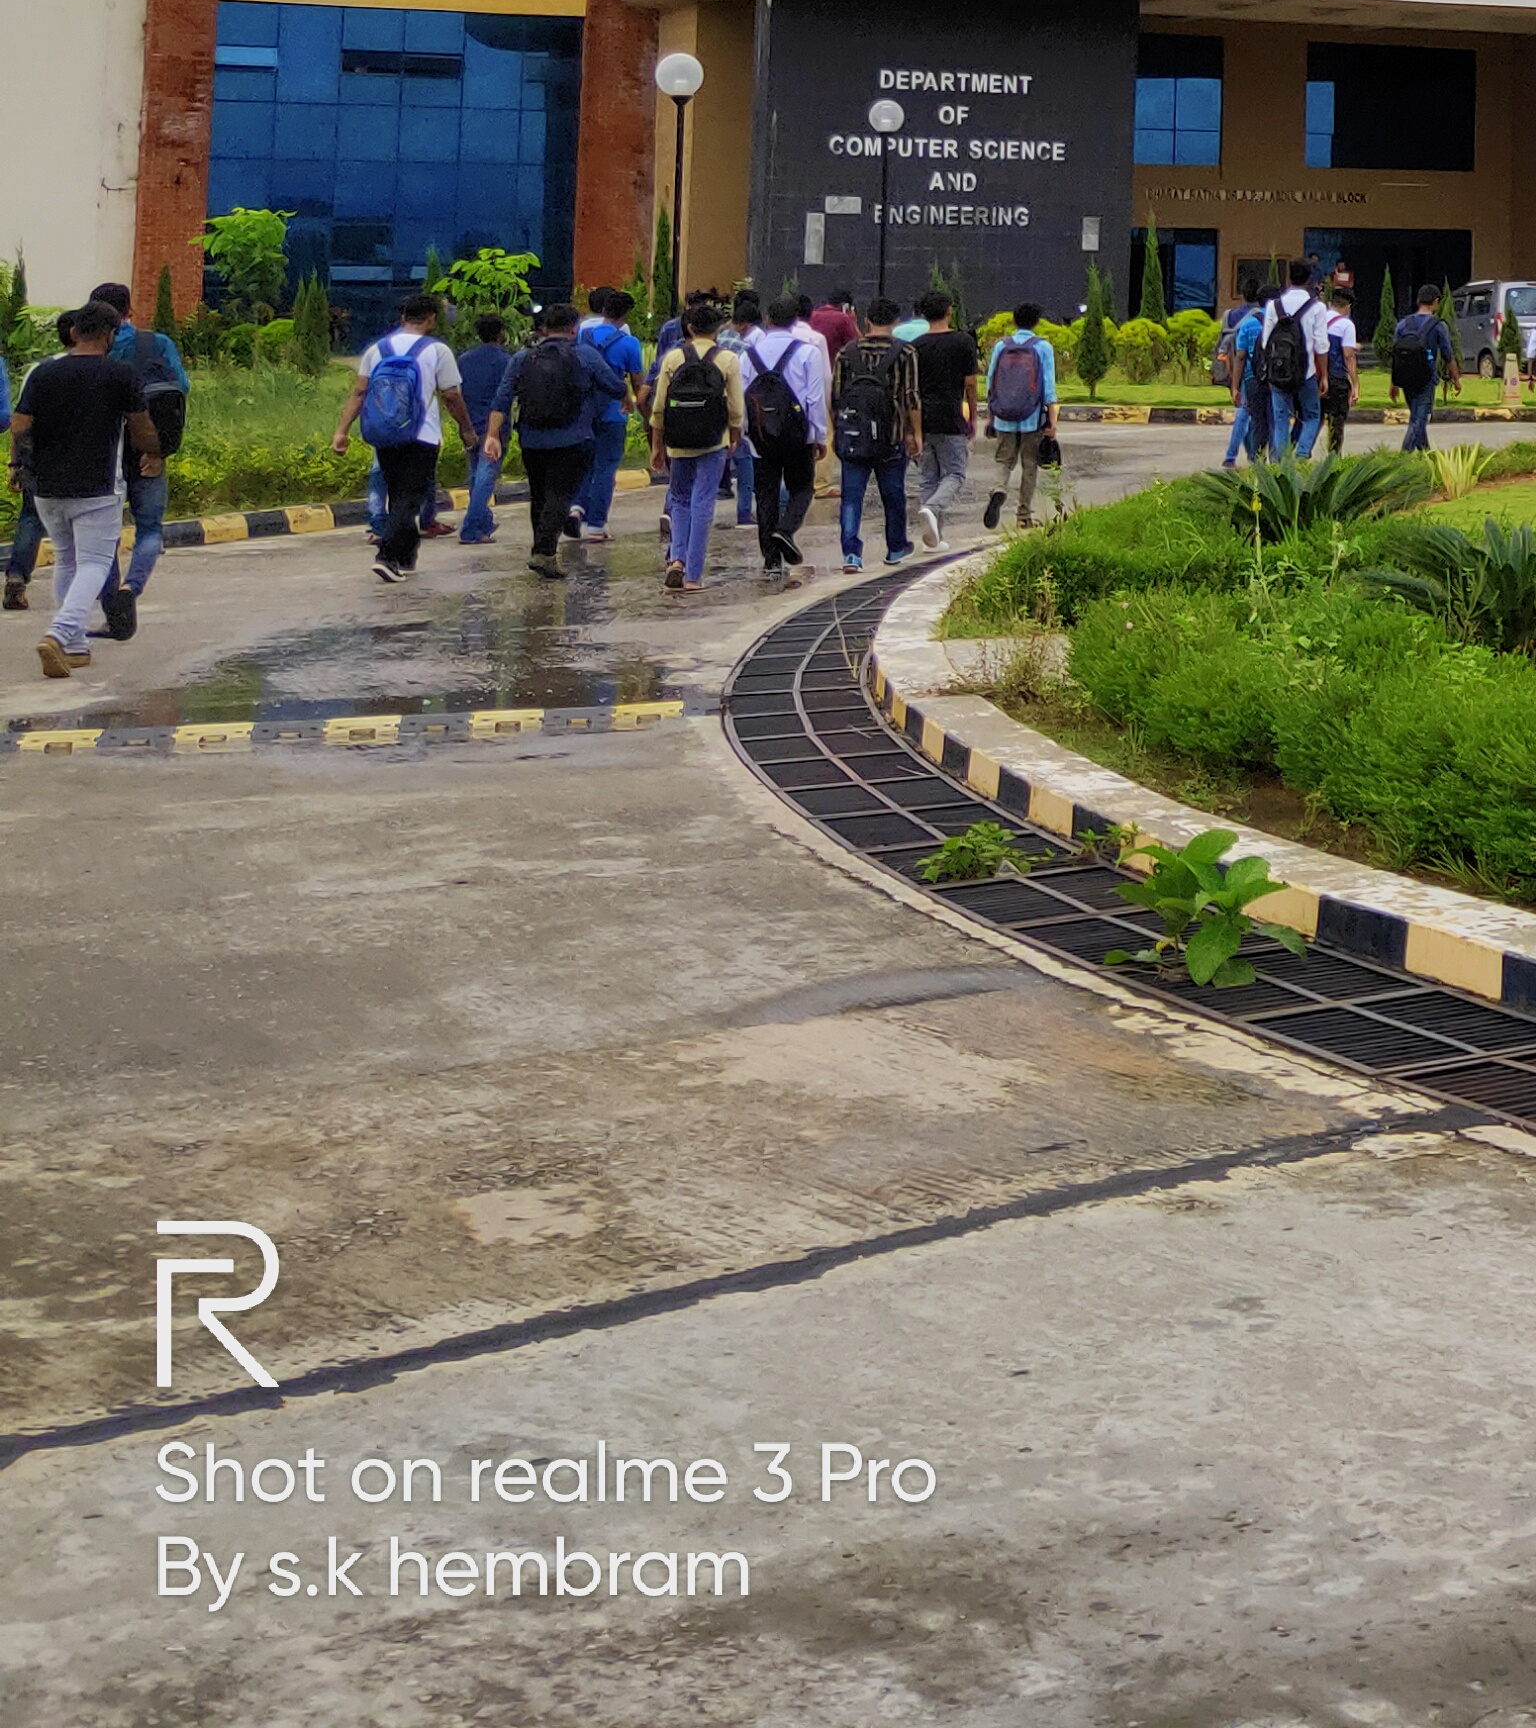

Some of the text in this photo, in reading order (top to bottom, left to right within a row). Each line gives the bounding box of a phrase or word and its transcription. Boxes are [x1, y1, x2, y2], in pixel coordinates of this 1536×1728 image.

[879, 69, 1033, 95] DEPARTMENT
[938, 105, 970, 125] OF
[969, 139, 1066, 161] SCIENCE
[928, 171, 977, 192] AND
[1336, 191, 1367, 204] BLOCK
